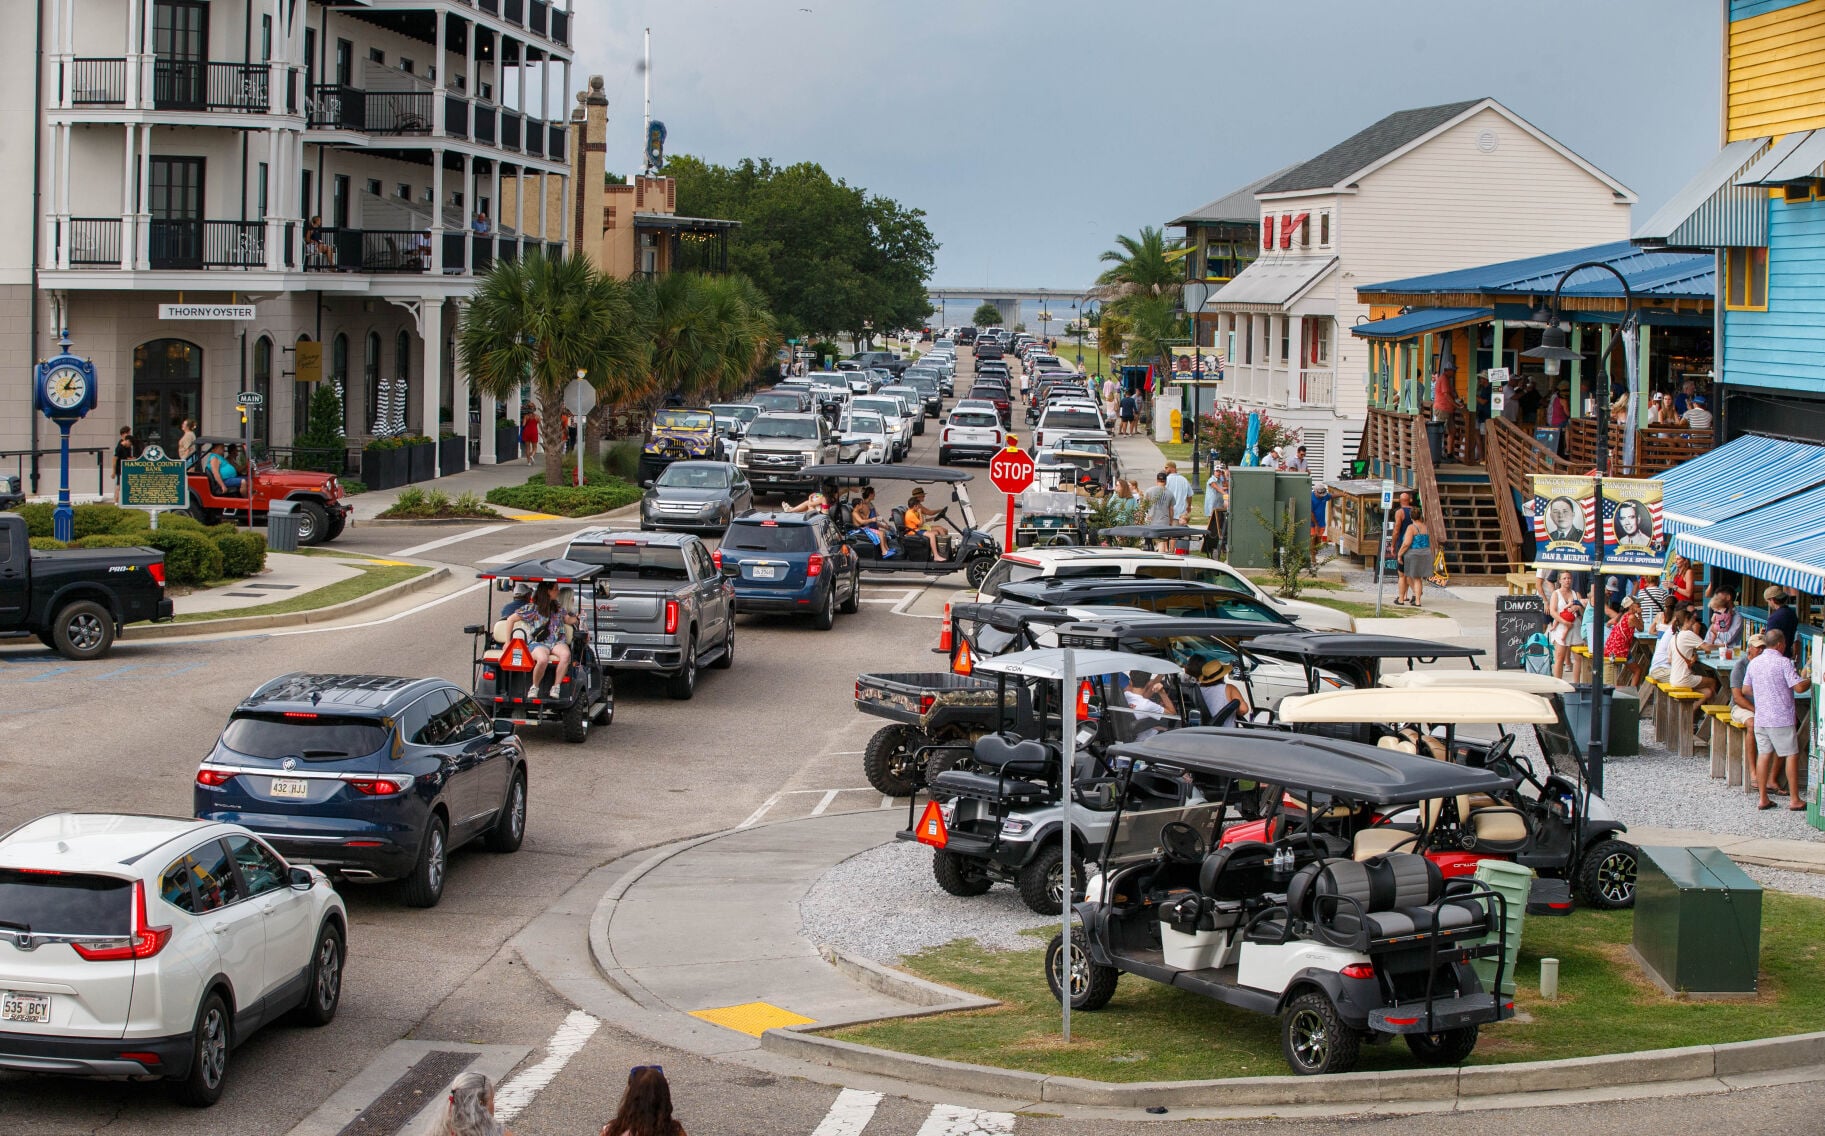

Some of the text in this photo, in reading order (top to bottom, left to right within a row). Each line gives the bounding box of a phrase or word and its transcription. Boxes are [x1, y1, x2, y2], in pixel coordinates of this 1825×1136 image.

[168, 307, 252, 317] THORNY OYSTER
[993, 461, 1032, 480] STOP
[1620, 491, 1646, 499] HONORS
[1562, 554, 1590, 562] MURPHY
[1428, 576, 1448, 587] OPEN
[1005, 664, 1023, 672] ICON
[273, 783, 306, 794] 432 HJJ
[5, 1000, 47, 1016] 535 BCY
